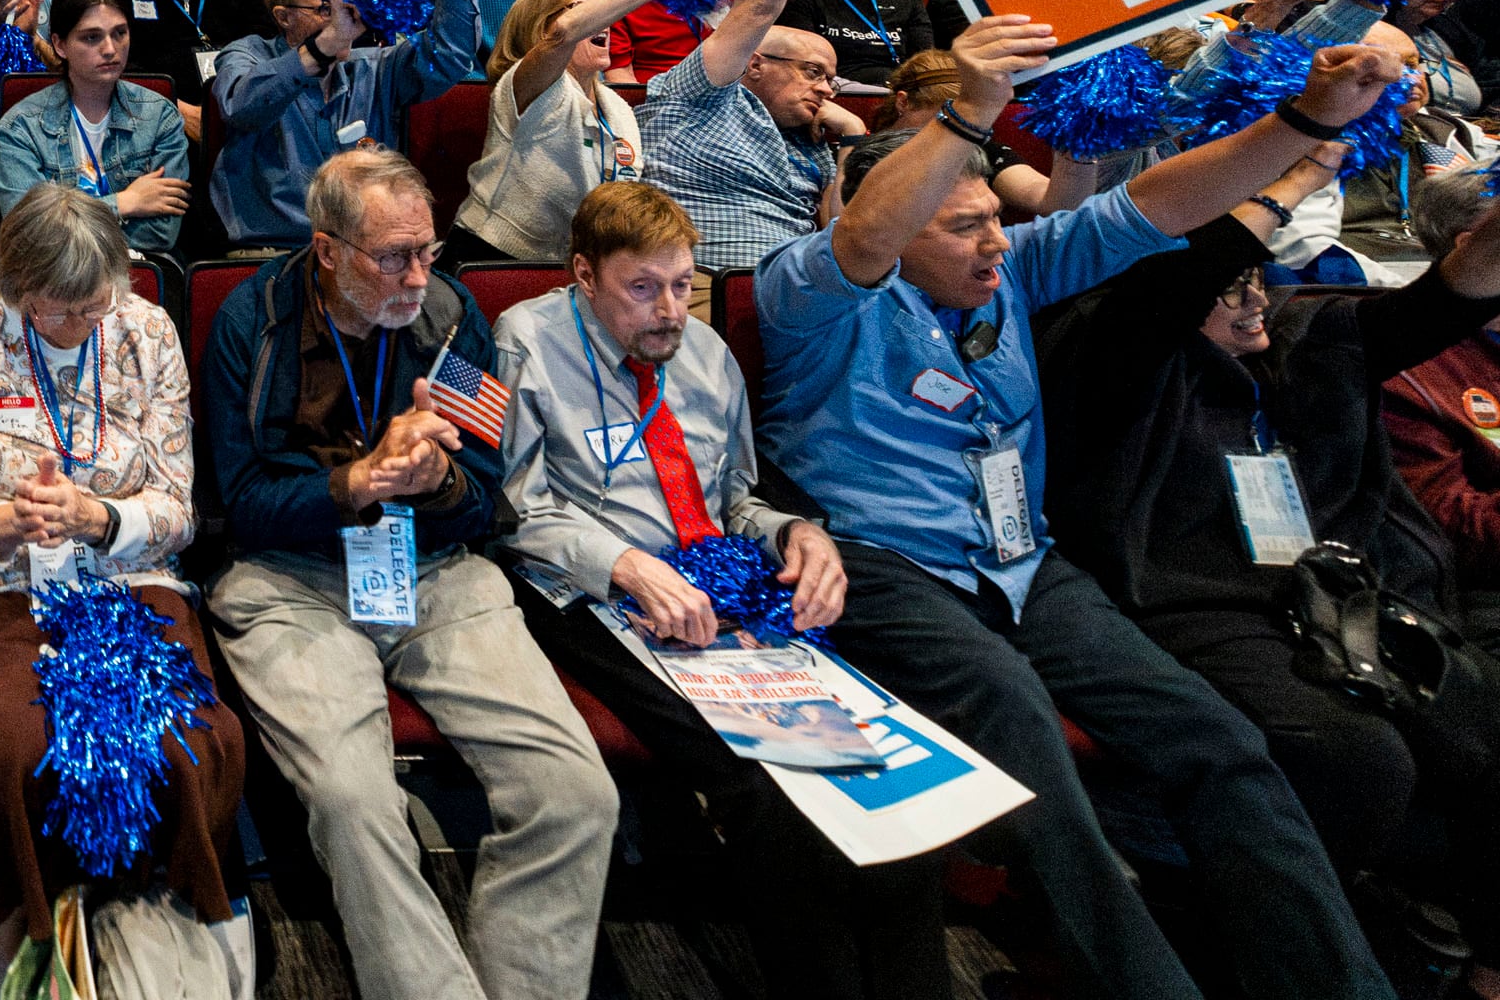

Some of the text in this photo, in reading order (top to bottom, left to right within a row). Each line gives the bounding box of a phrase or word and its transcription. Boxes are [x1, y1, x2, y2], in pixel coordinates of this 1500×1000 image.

[388, 523, 409, 616] DELEGATE
[674, 671, 815, 685] TOGETHER WE WIN
[685, 685, 828, 699] TOGETHER WE RUN
